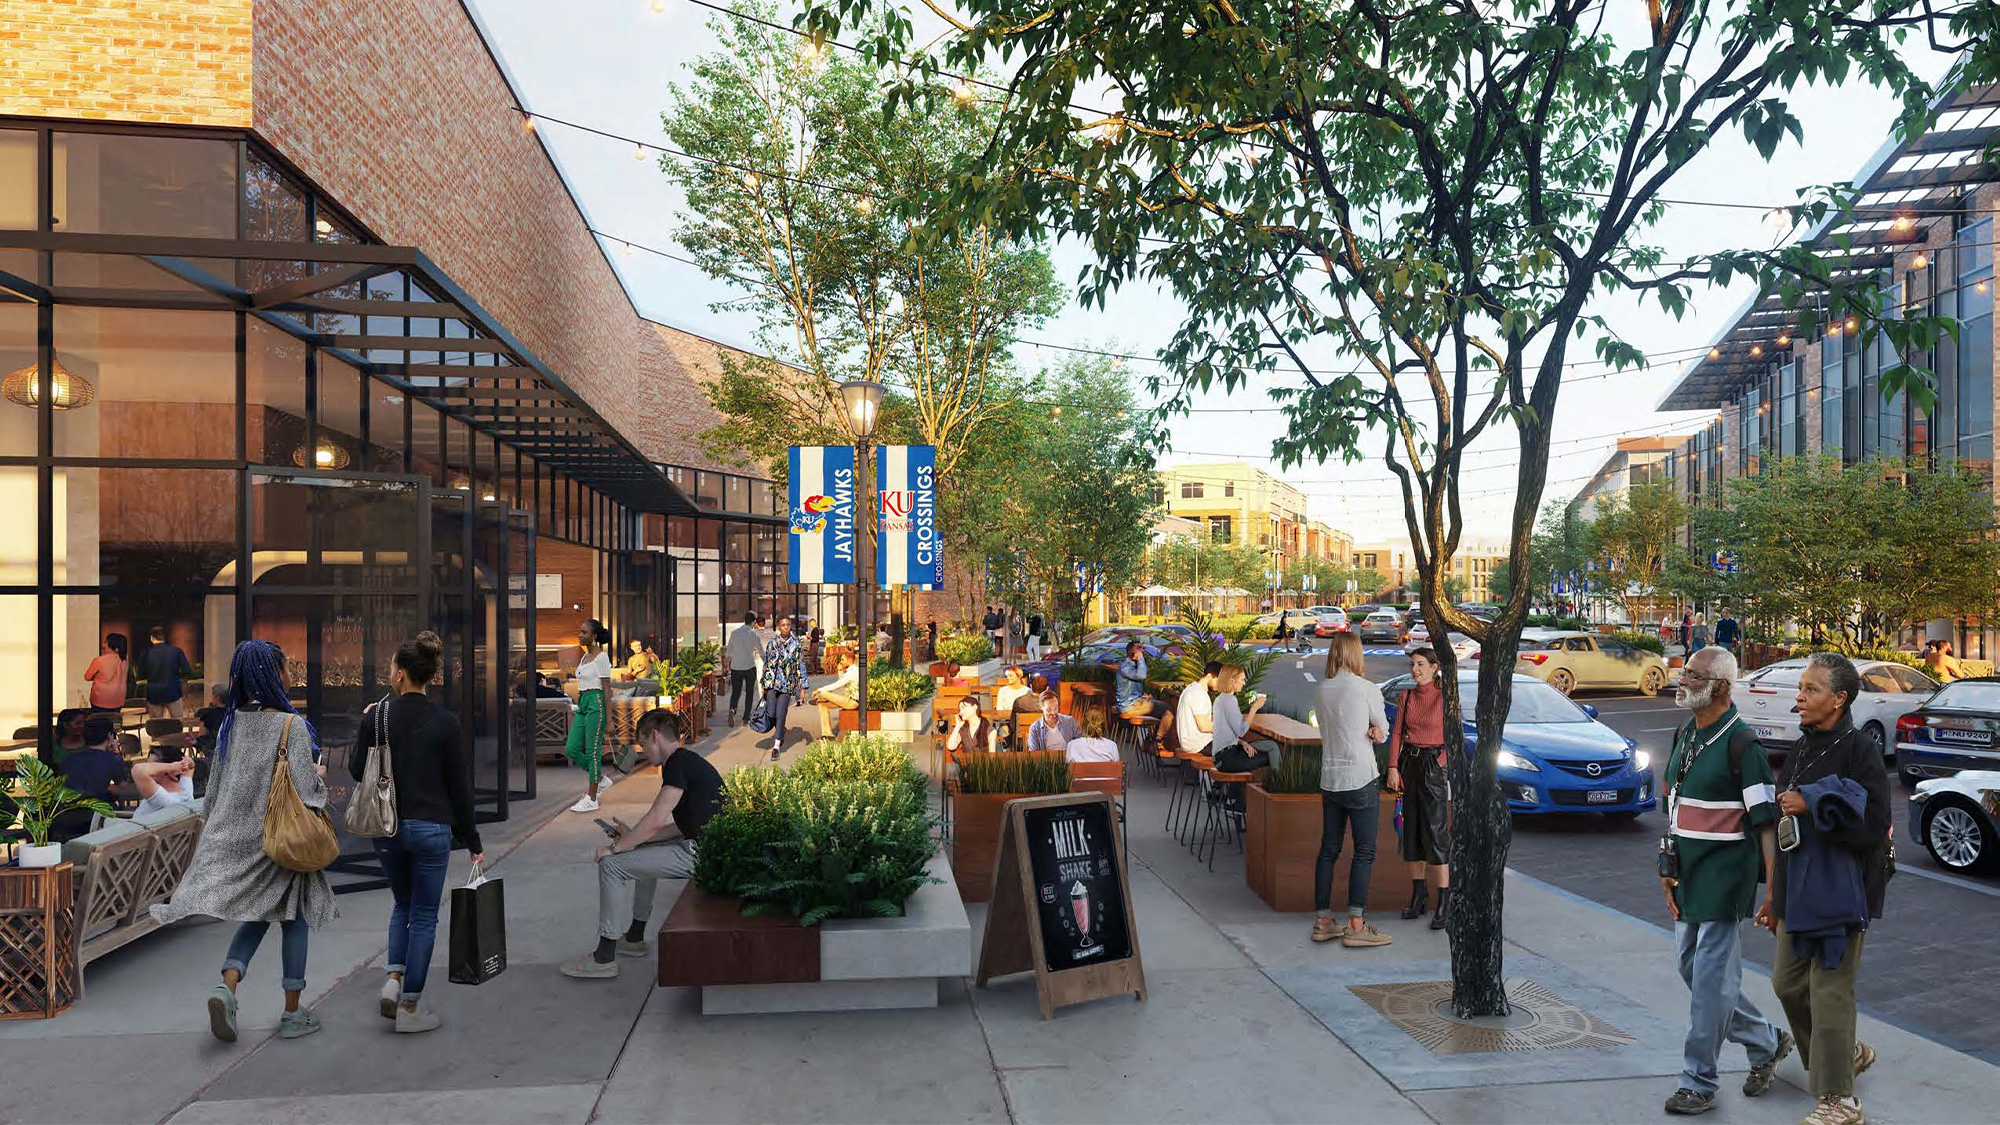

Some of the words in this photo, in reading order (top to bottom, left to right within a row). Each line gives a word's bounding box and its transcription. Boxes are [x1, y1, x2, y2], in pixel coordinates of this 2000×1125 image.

[802, 515, 815, 524] KU
[834, 468, 852, 562] JAYHAWKS
[880, 491, 914, 516] KU
[917, 465, 933, 565] CROSSINGS
[880, 522, 913, 531] KANSAS
[935, 539, 943, 583] CROSSINGS
[1052, 819, 1091, 859] MILK
[1060, 861, 1093, 882] SHAKE
